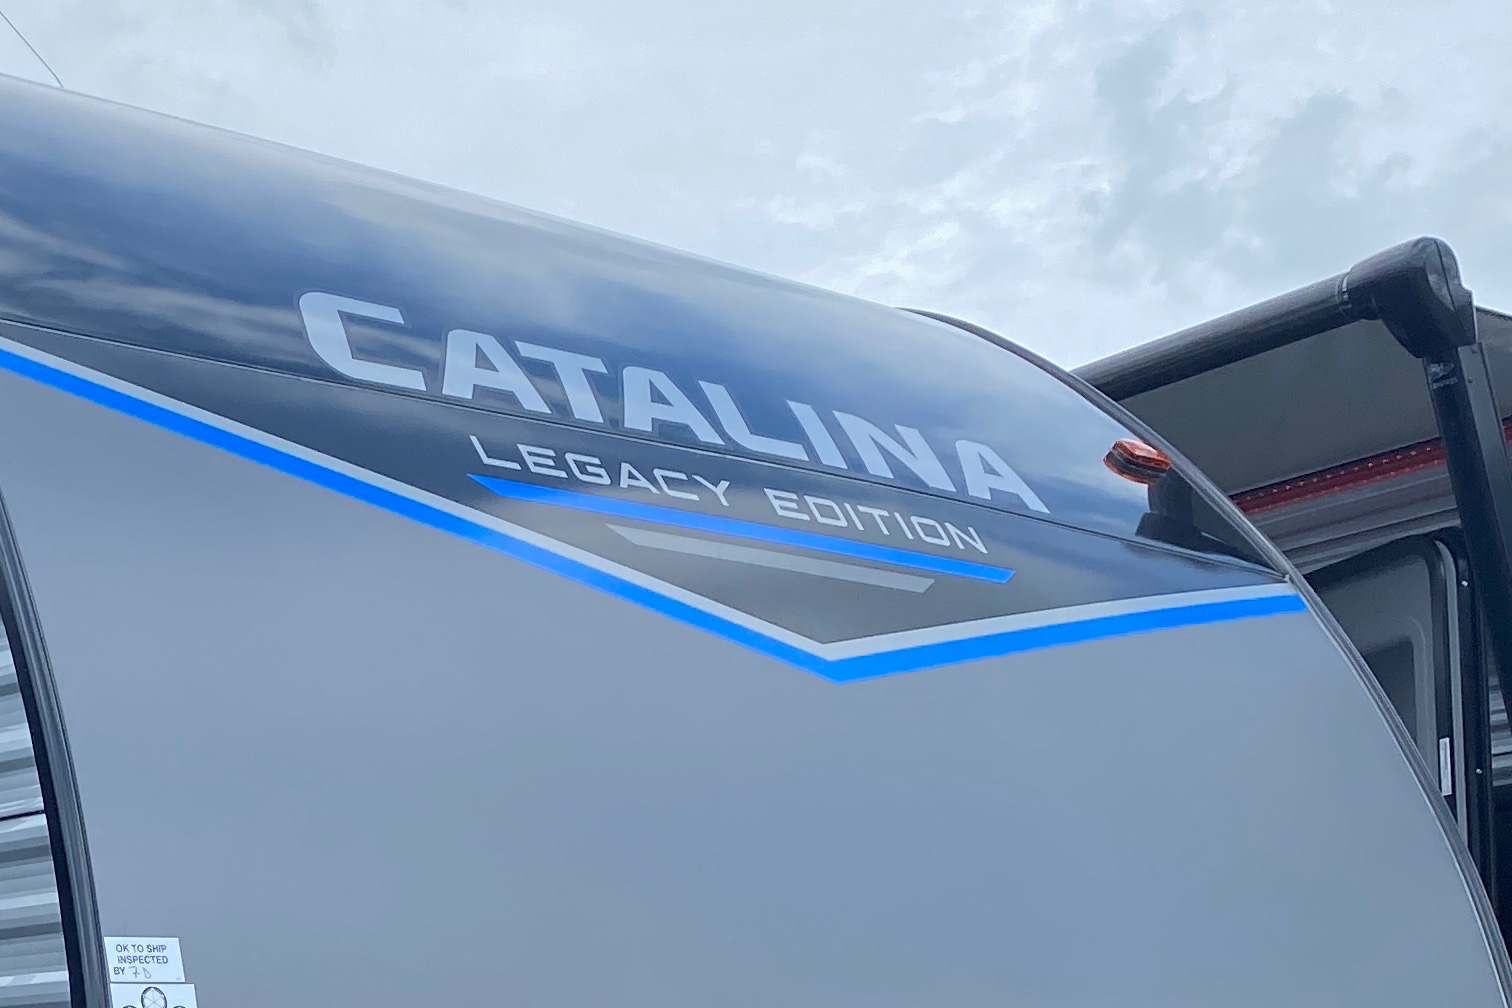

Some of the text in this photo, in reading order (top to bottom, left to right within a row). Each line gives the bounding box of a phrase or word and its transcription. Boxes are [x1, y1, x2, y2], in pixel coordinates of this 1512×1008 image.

[298, 291, 1052, 515] CATALINA
[468, 434, 989, 554] LEGACY EDITION
[115, 943, 167, 953] OK TO SHIP
[117, 955, 169, 965] INSPECTED
[113, 966, 125, 976] BY
